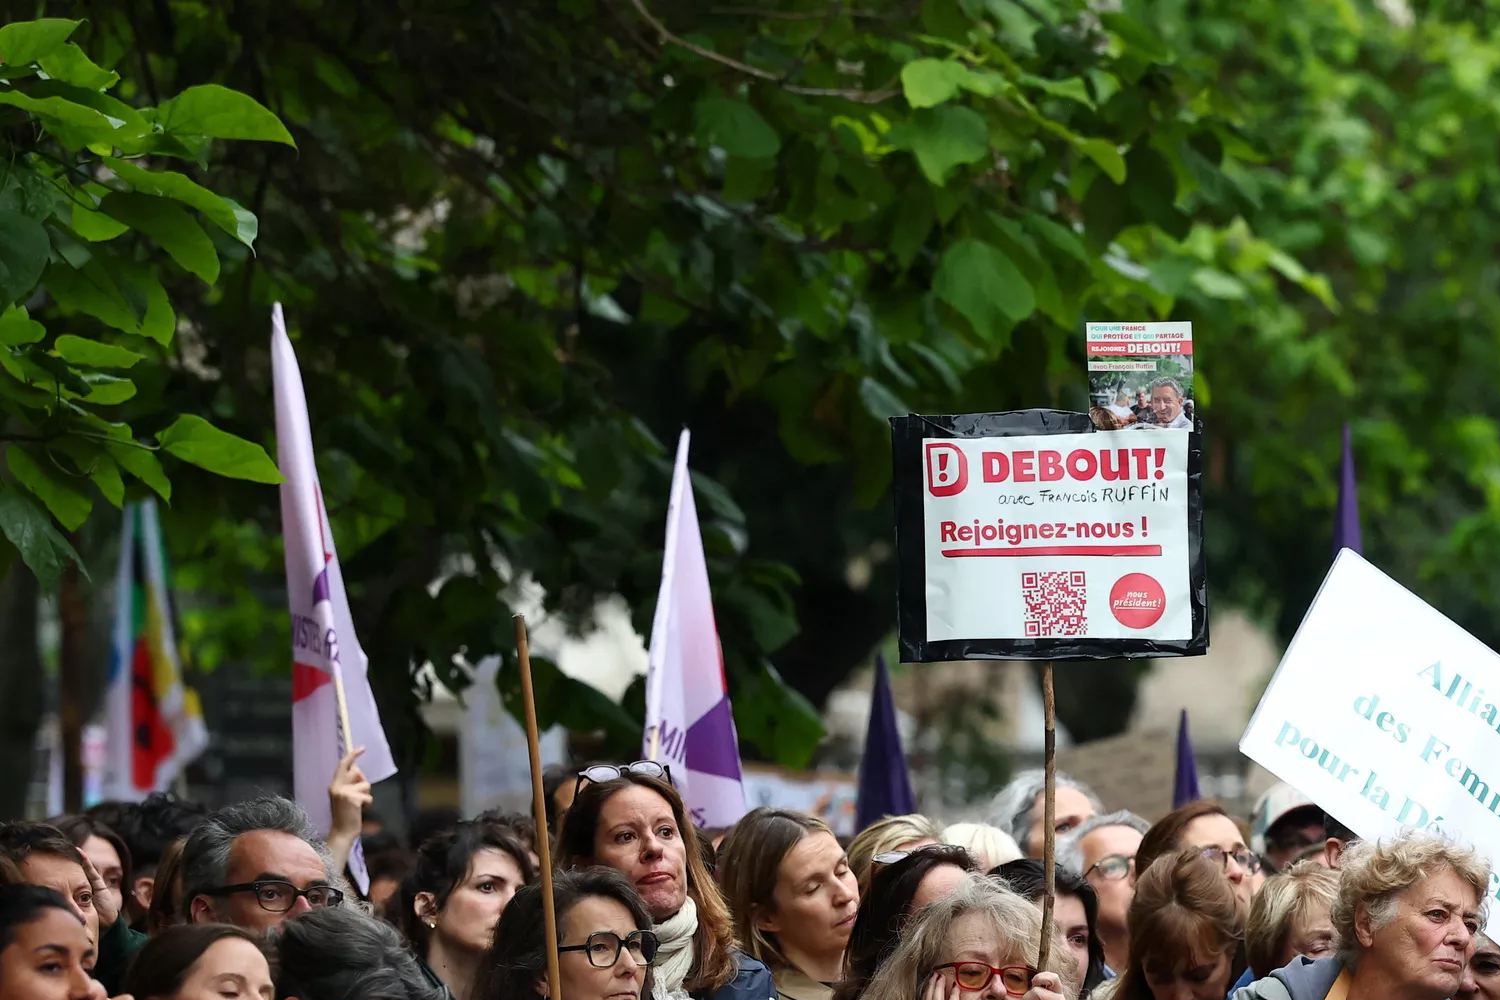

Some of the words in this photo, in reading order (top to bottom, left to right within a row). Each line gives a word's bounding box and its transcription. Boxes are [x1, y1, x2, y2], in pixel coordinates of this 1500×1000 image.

[1128, 342, 1181, 353] DEBOUT!
[982, 447, 1166, 483] DEBOUT!
[940, 519, 1134, 545] Rejoignez-nous
[1126, 591, 1148, 599] nous
[1353, 693, 1412, 744] des
[1274, 720, 1360, 784] pour
[1360, 769, 1391, 811] la
